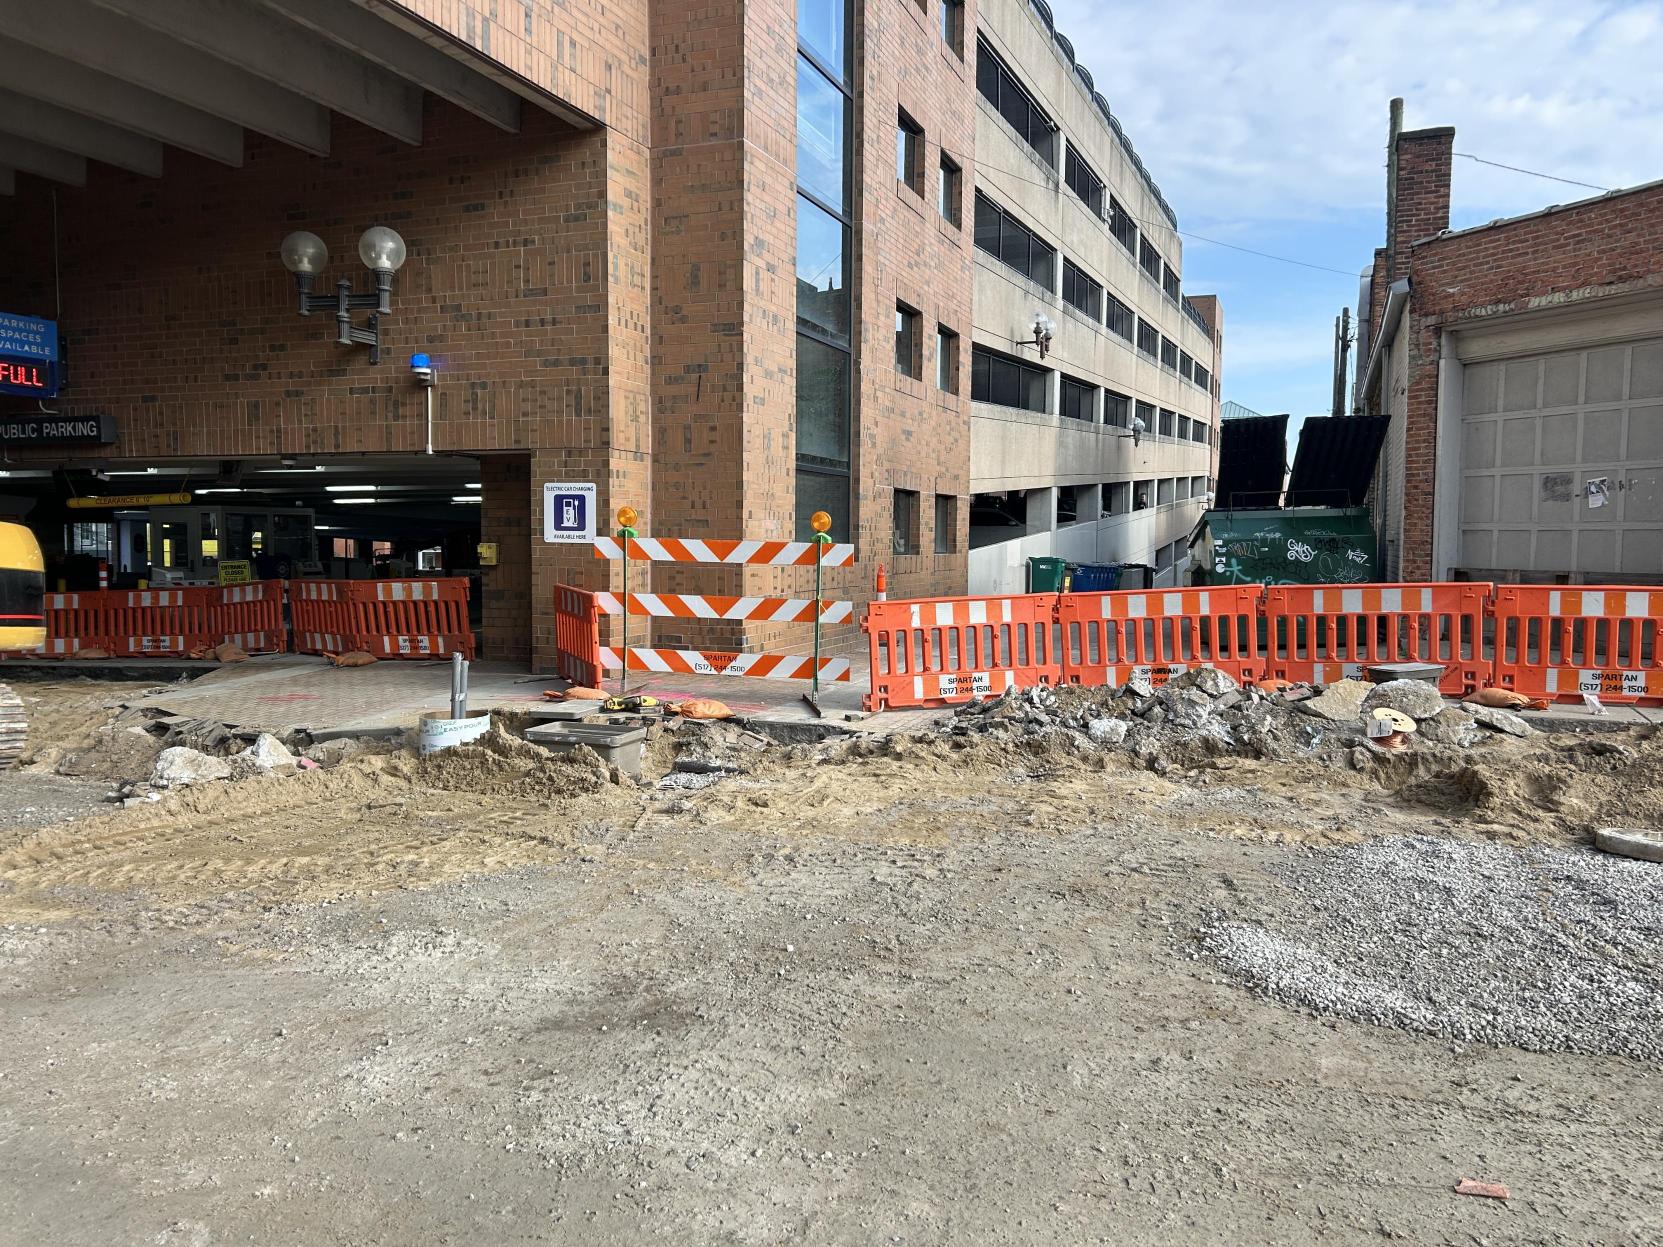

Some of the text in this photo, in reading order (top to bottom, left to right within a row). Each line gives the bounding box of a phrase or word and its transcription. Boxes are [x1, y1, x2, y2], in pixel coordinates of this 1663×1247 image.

[0, 329, 41, 342] SPACES
[0, 341, 51, 355] VAILABLE
[0, 363, 43, 387] FULL
[43, 421, 97, 437] PARKING
[703, 654, 737, 663] SPARTAN
[694, 662, 746, 673] (517) 244-1500
[947, 675, 983, 685] SPARTAN
[1591, 672, 1638, 682] SPARTAN
[939, 685, 993, 696] (517) 244-1500
[1579, 682, 1649, 693] (517) 244-1500
